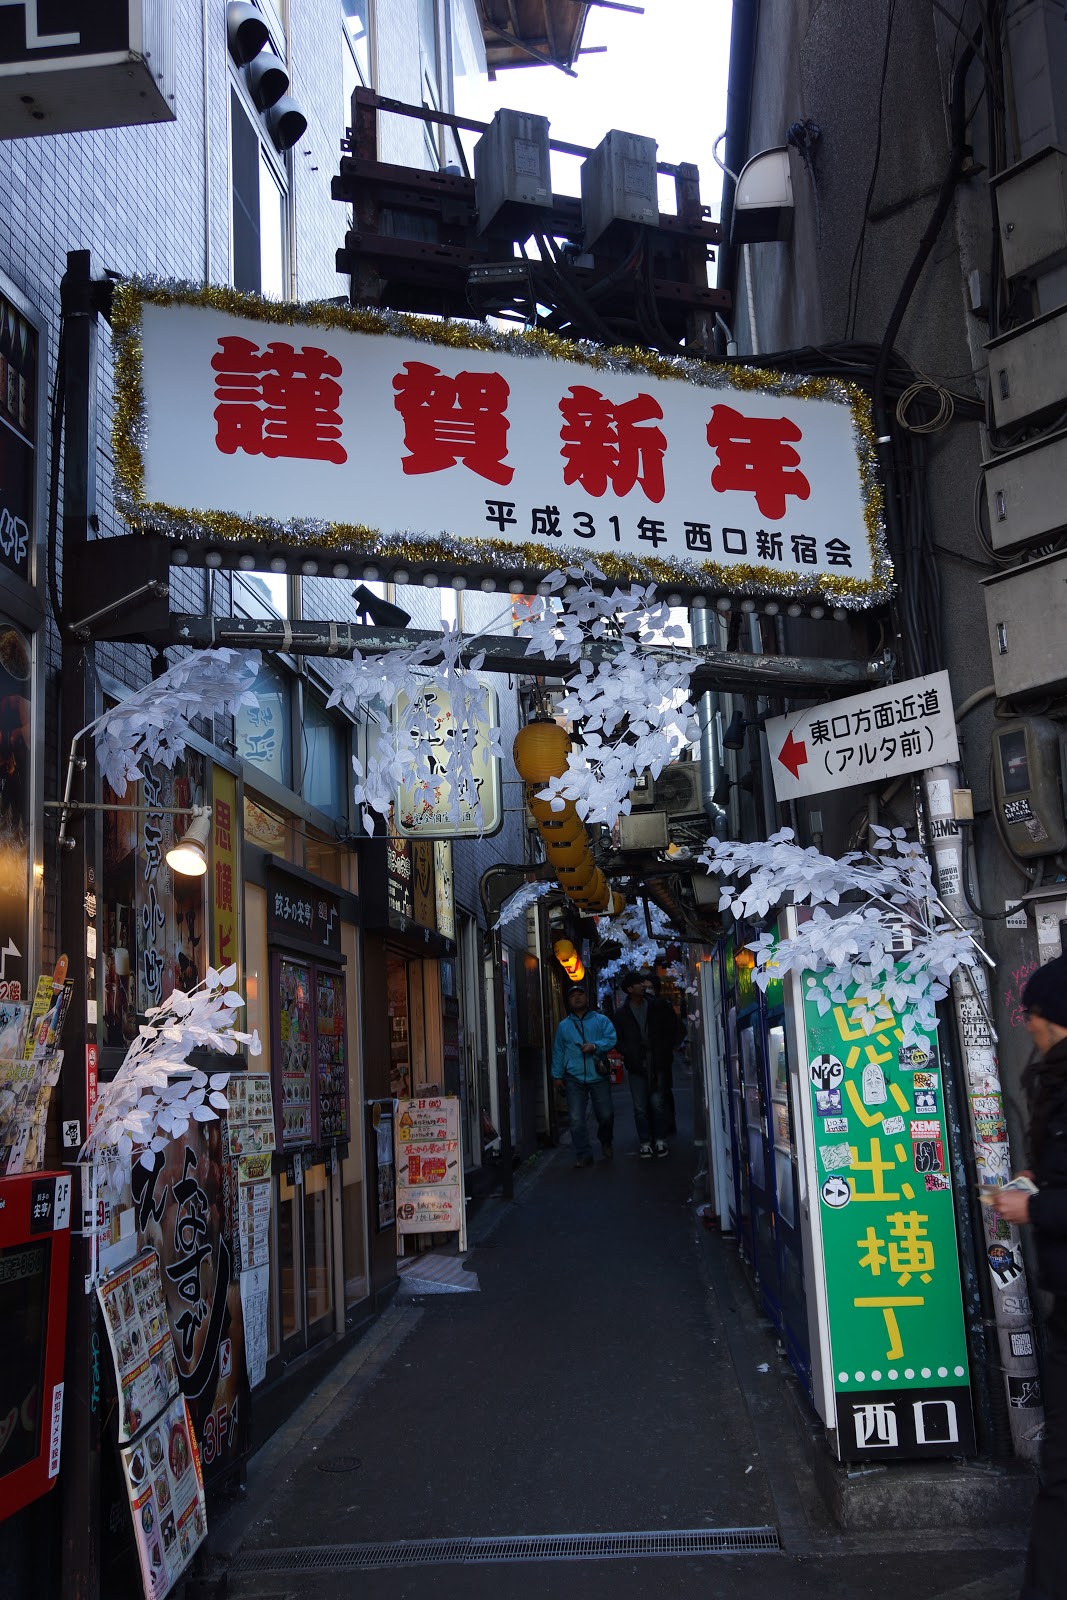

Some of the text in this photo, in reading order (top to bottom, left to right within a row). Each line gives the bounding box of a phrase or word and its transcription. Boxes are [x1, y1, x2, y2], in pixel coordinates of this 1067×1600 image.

[211, 336, 811, 520] 謹賀新年
[485, 500, 853, 568] 平成31年 西口新宿会
[809, 689, 940, 745] 東口方面近道
[57, 1184, 69, 1202] 2F
[203, 1406, 228, 1464] 3F
[852, 1400, 959, 1448] 西口
